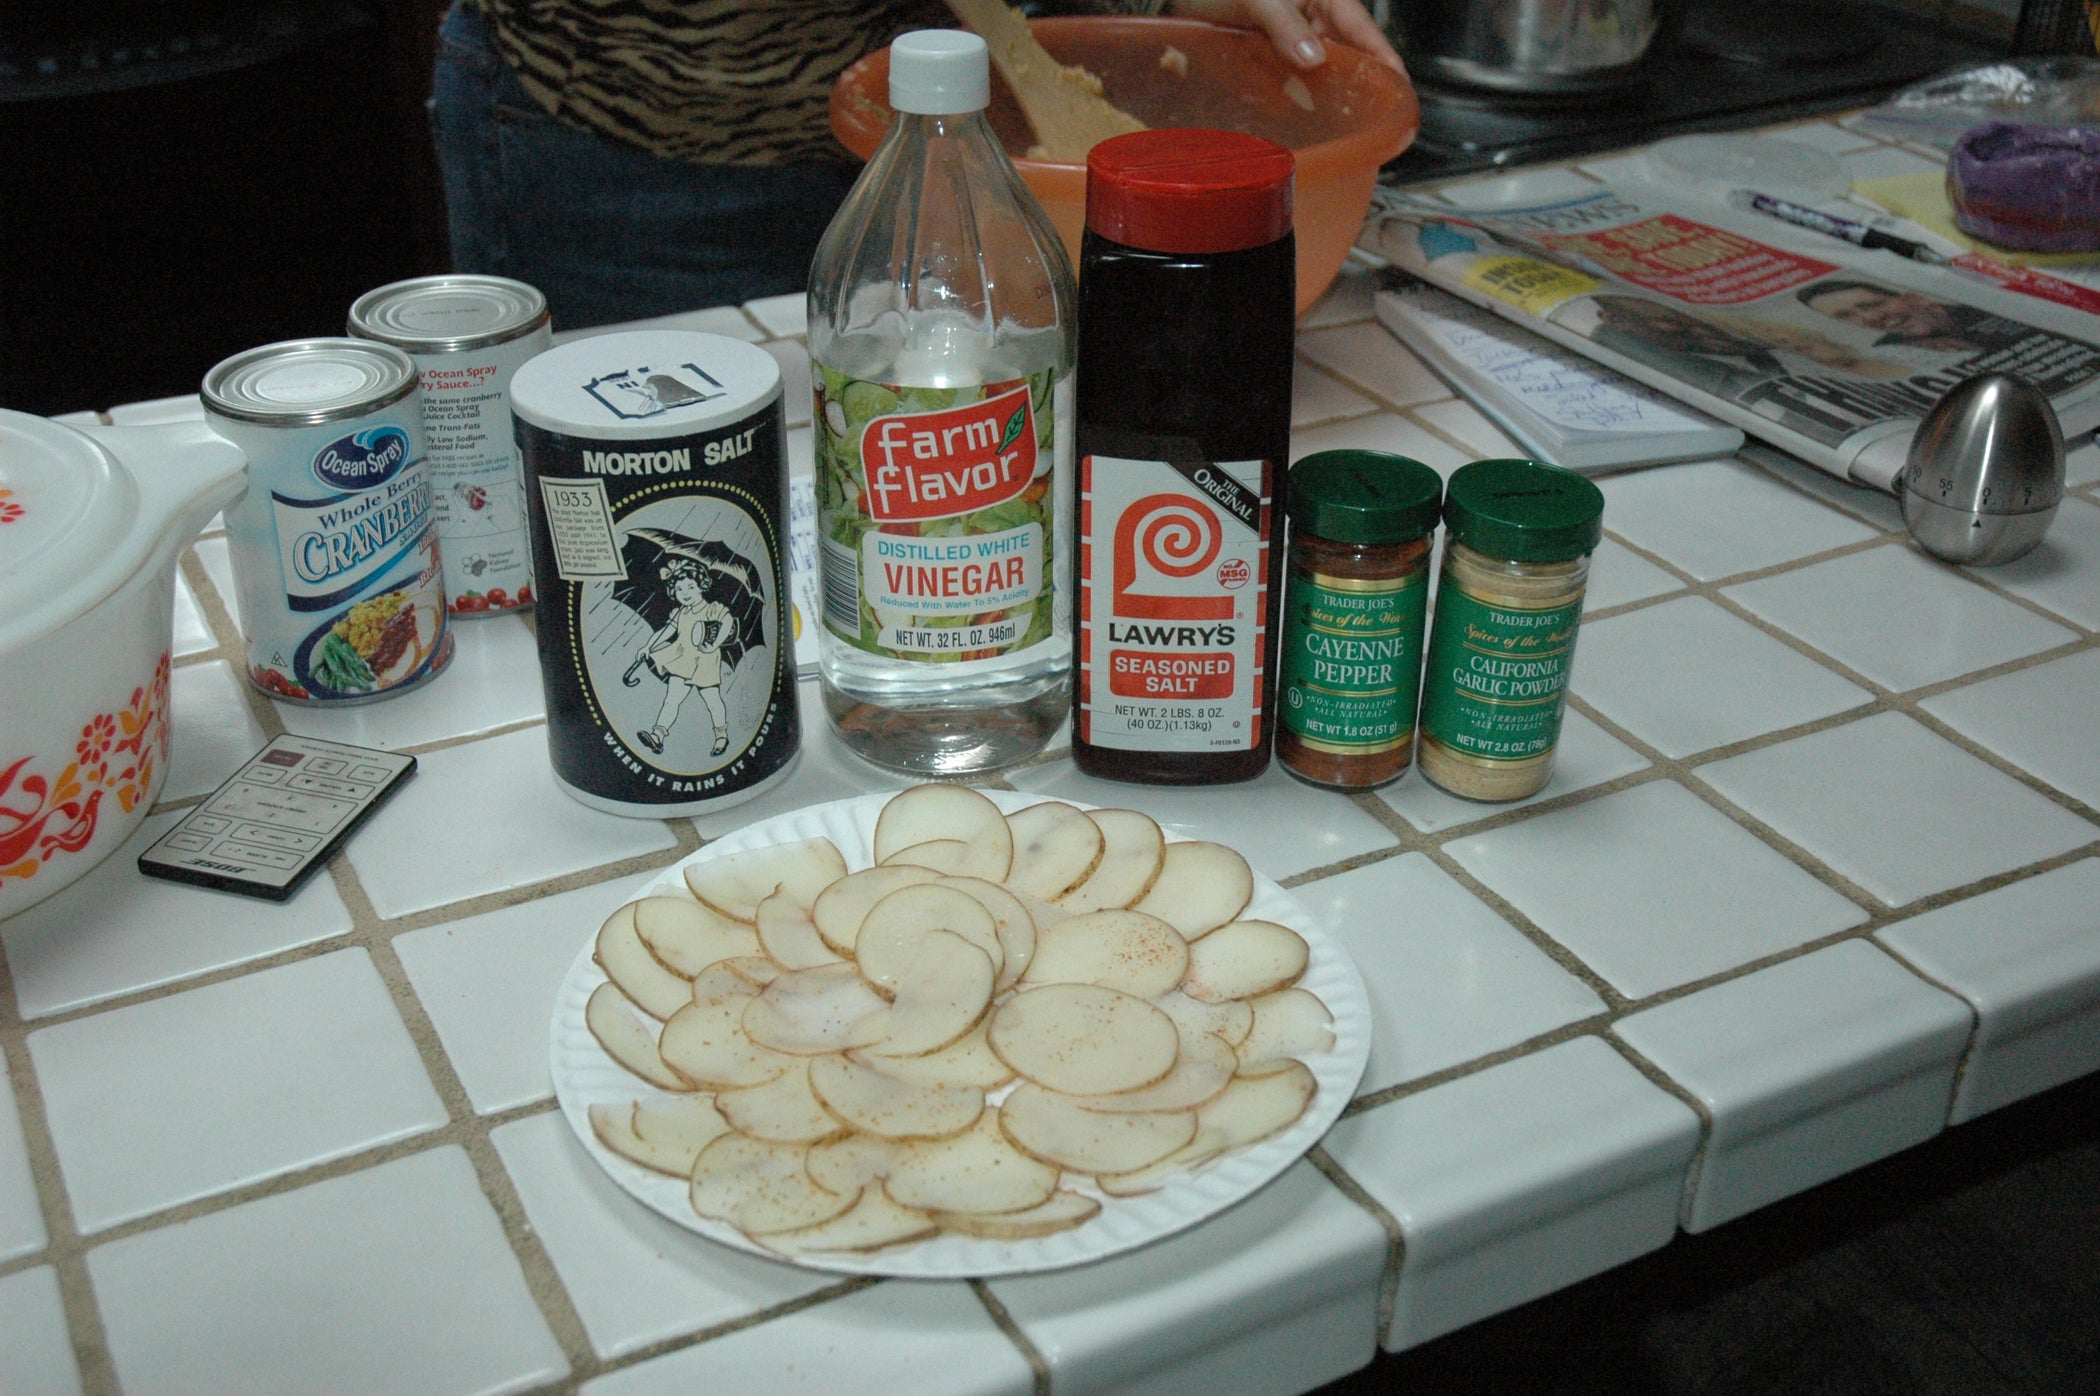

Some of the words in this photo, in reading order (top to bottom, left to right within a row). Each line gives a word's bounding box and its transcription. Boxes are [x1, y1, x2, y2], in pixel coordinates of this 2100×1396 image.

[429, 369, 464, 379] Ocean
[466, 365, 497, 377] Spray
[462, 392, 502, 403] cranberry
[428, 404, 454, 413] Ocean
[456, 403, 480, 414] Spray
[447, 410, 480, 420] Cocktail
[582, 448, 692, 476] MORTON
[704, 428, 756, 466] SALT
[878, 416, 1001, 478] farm
[321, 449, 367, 477] Ocean
[366, 438, 403, 474] Spray
[873, 451, 1019, 513] flavor
[1222, 479, 1241, 495] THE
[1938, 478, 1954, 492] 55
[317, 494, 382, 530] Whole
[387, 470, 423, 499] Berry
[553, 490, 593, 508] 1933
[1193, 468, 1253, 521] ORIGINAL
[1982, 487, 1991, 498] 0
[2024, 486, 2033, 498] 5
[878, 540, 972, 561] DISTILLED
[977, 532, 1030, 557] WHITE
[883, 556, 1025, 598] VINEGAR
[1220, 568, 1248, 578] MSG
[880, 596, 919, 609] Reduced
[921, 600, 943, 610] With
[945, 599, 971, 610] Water
[974, 598, 985, 607] To
[1002, 588, 1030, 602] Acidity
[1322, 594, 1365, 609] TRADER
[1367, 597, 1395, 611] JOE'S
[1336, 613, 1354, 627] of
[1352, 614, 1374, 626] the
[1489, 612, 1534, 627] TRADER
[1533, 614, 1561, 629] JOE'S
[896, 629, 914, 647] NET
[916, 632, 935, 648] WT.
[937, 633, 949, 648] 32
[952, 632, 967, 647] FL.
[970, 629, 986, 645] OZ.
[988, 622, 1016, 642] 946ml
[1109, 622, 1236, 647] LAWRY'S
[1463, 623, 1499, 643] Spices
[1503, 635, 1520, 649] of
[1520, 635, 1541, 647] the
[1305, 633, 1405, 662] CAYENNE
[1114, 656, 1231, 676] SEASONED
[1313, 659, 1393, 686] PEPPER
[1470, 655, 1559, 679] CALIFORNIA
[1145, 677, 1198, 693] SALT
[1452, 667, 1508, 696] GARLIC
[1115, 704, 1136, 716] NET
[1138, 707, 1158, 718] WT.
[1160, 708, 1168, 718] 2
[1170, 708, 1195, 719] LBS.
[1197, 708, 1205, 718] 8
[1207, 707, 1225, 718] OZ.
[1127, 718, 1144, 731] (40
[1306, 718, 1325, 732] NET
[1326, 723, 1342, 736] WT
[1344, 725, 1358, 737] 1.8
[1359, 725, 1374, 737] OZ
[1374, 724, 1387, 736] (51
[603, 732, 643, 775] WHEN
[647, 774, 665, 787] IT
[672, 775, 725, 792] RAINS
[730, 760, 745, 776] IT
[748, 703, 778, 757] POURS
[1456, 733, 1476, 747] NET
[1477, 738, 1493, 750] WT
[1494, 742, 1509, 752] 2.8
[1511, 742, 1525, 752] OZ
